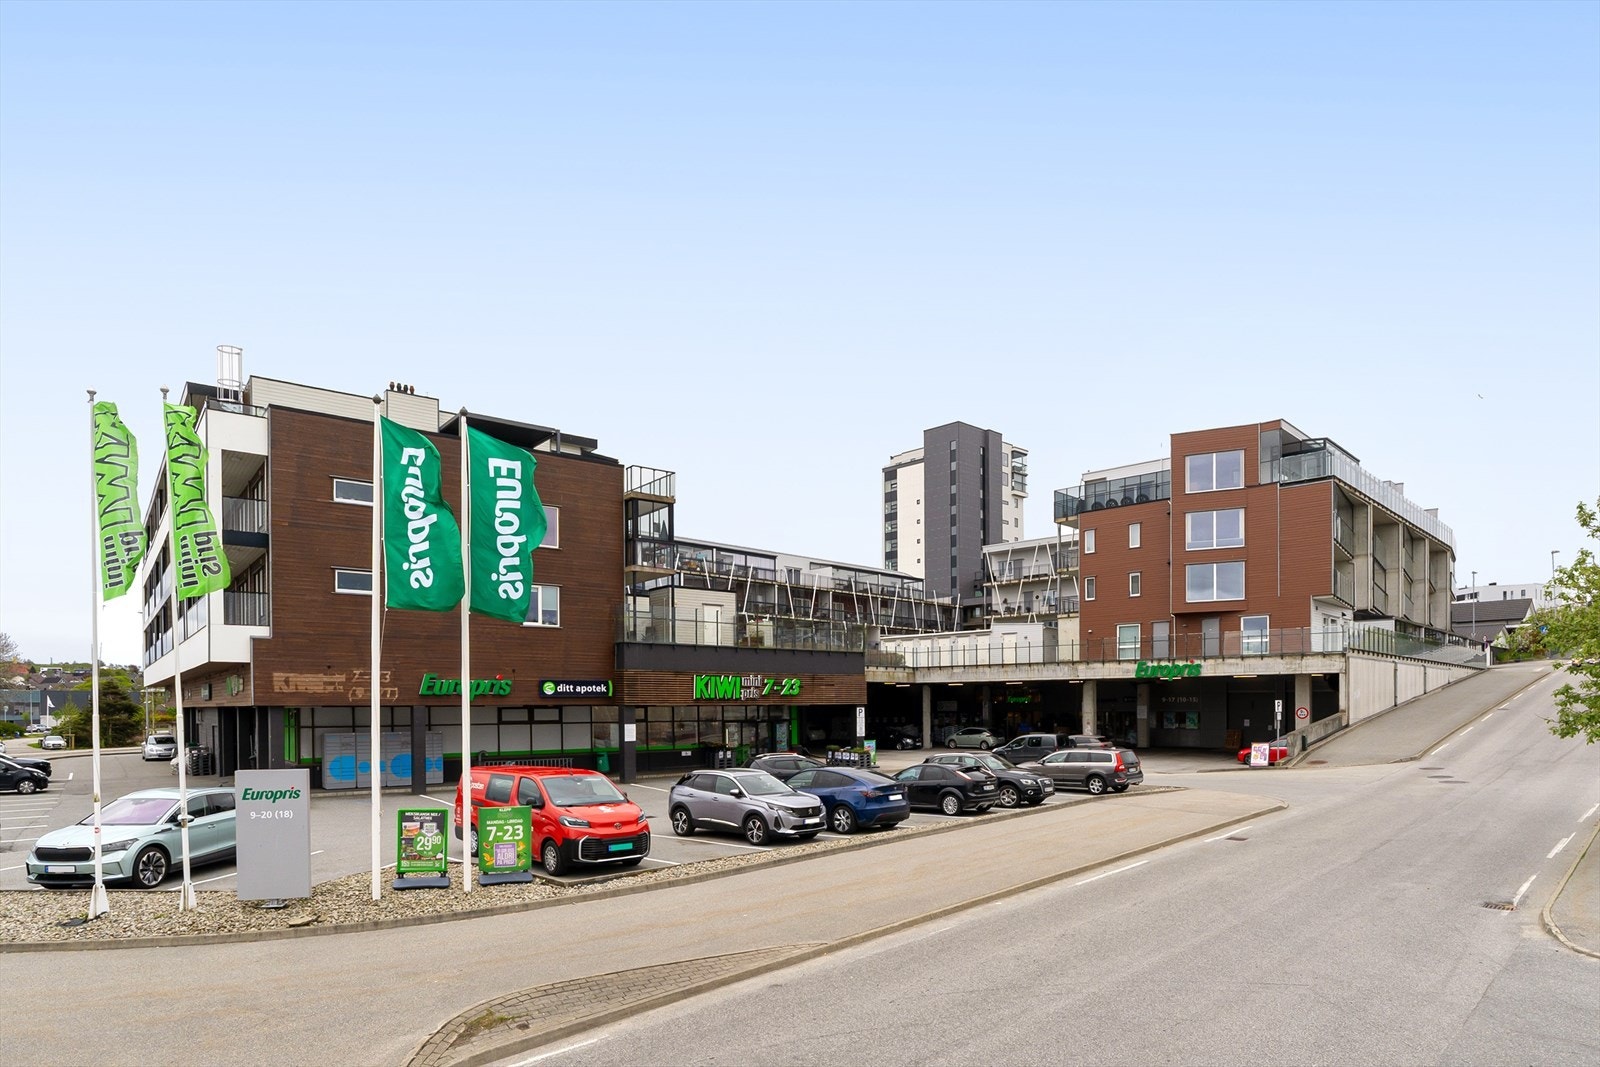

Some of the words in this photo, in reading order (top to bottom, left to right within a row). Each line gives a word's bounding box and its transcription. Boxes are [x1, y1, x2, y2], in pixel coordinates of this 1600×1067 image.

[1135, 659, 1202, 681] Europris
[557, 681, 574, 693] ditt
[575, 682, 607, 696] apotek
[693, 674, 741, 700] KIWI
[741, 675, 763, 686] mini
[740, 687, 760, 700] pris
[241, 786, 302, 804] Europris
[274, 810, 294, 819] (18)
[486, 824, 524, 841] 7-23
